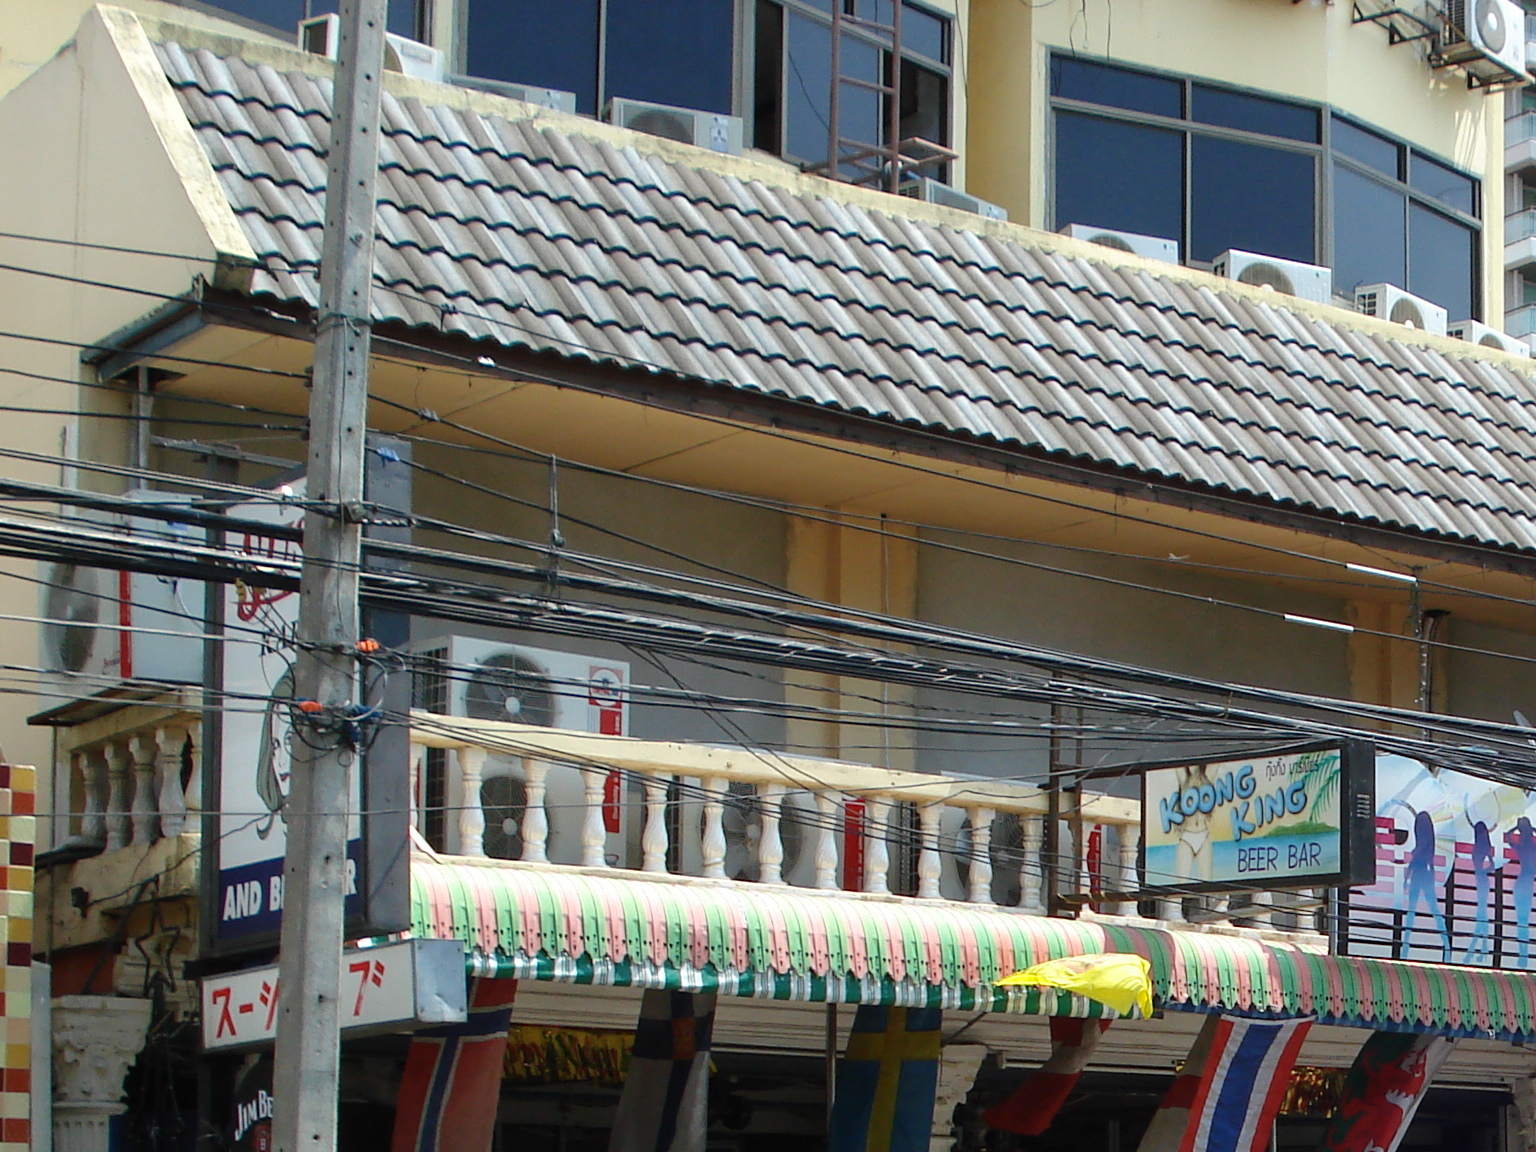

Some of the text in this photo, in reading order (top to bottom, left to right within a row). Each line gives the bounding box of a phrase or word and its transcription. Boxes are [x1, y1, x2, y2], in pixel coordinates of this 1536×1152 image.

[1159, 765, 1256, 834] KOONG
[1231, 780, 1307, 842] KING
[1237, 842, 1322, 873] BEER BAR
[223, 880, 262, 921] AND
[235, 1090, 274, 1141] JIM BE
